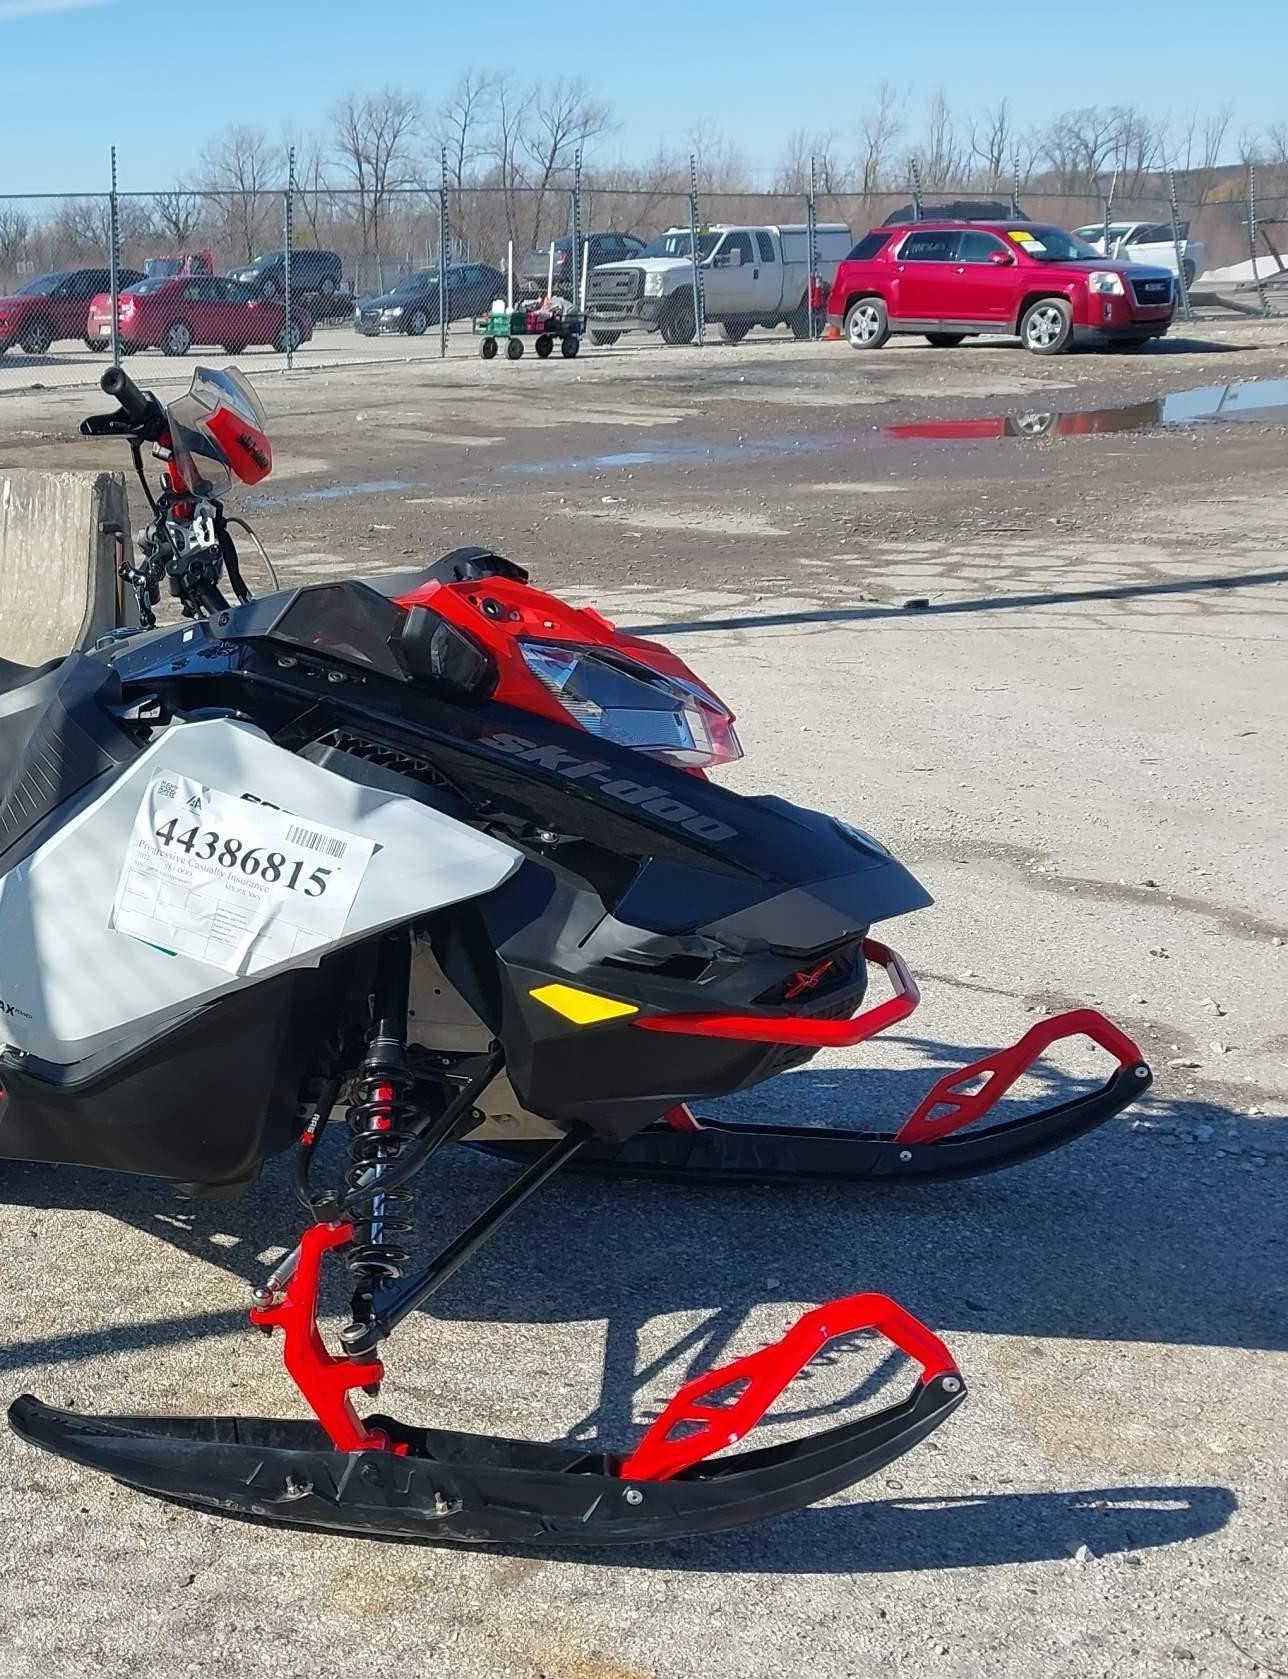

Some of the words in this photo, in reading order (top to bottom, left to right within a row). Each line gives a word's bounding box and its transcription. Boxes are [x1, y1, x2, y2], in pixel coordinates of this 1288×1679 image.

[478, 732, 739, 842] ski-doo
[138, 839, 186, 865] Progressive
[187, 857, 225, 879] Casualty
[227, 871, 270, 893] Insurance
[155, 817, 334, 897] 44386815
